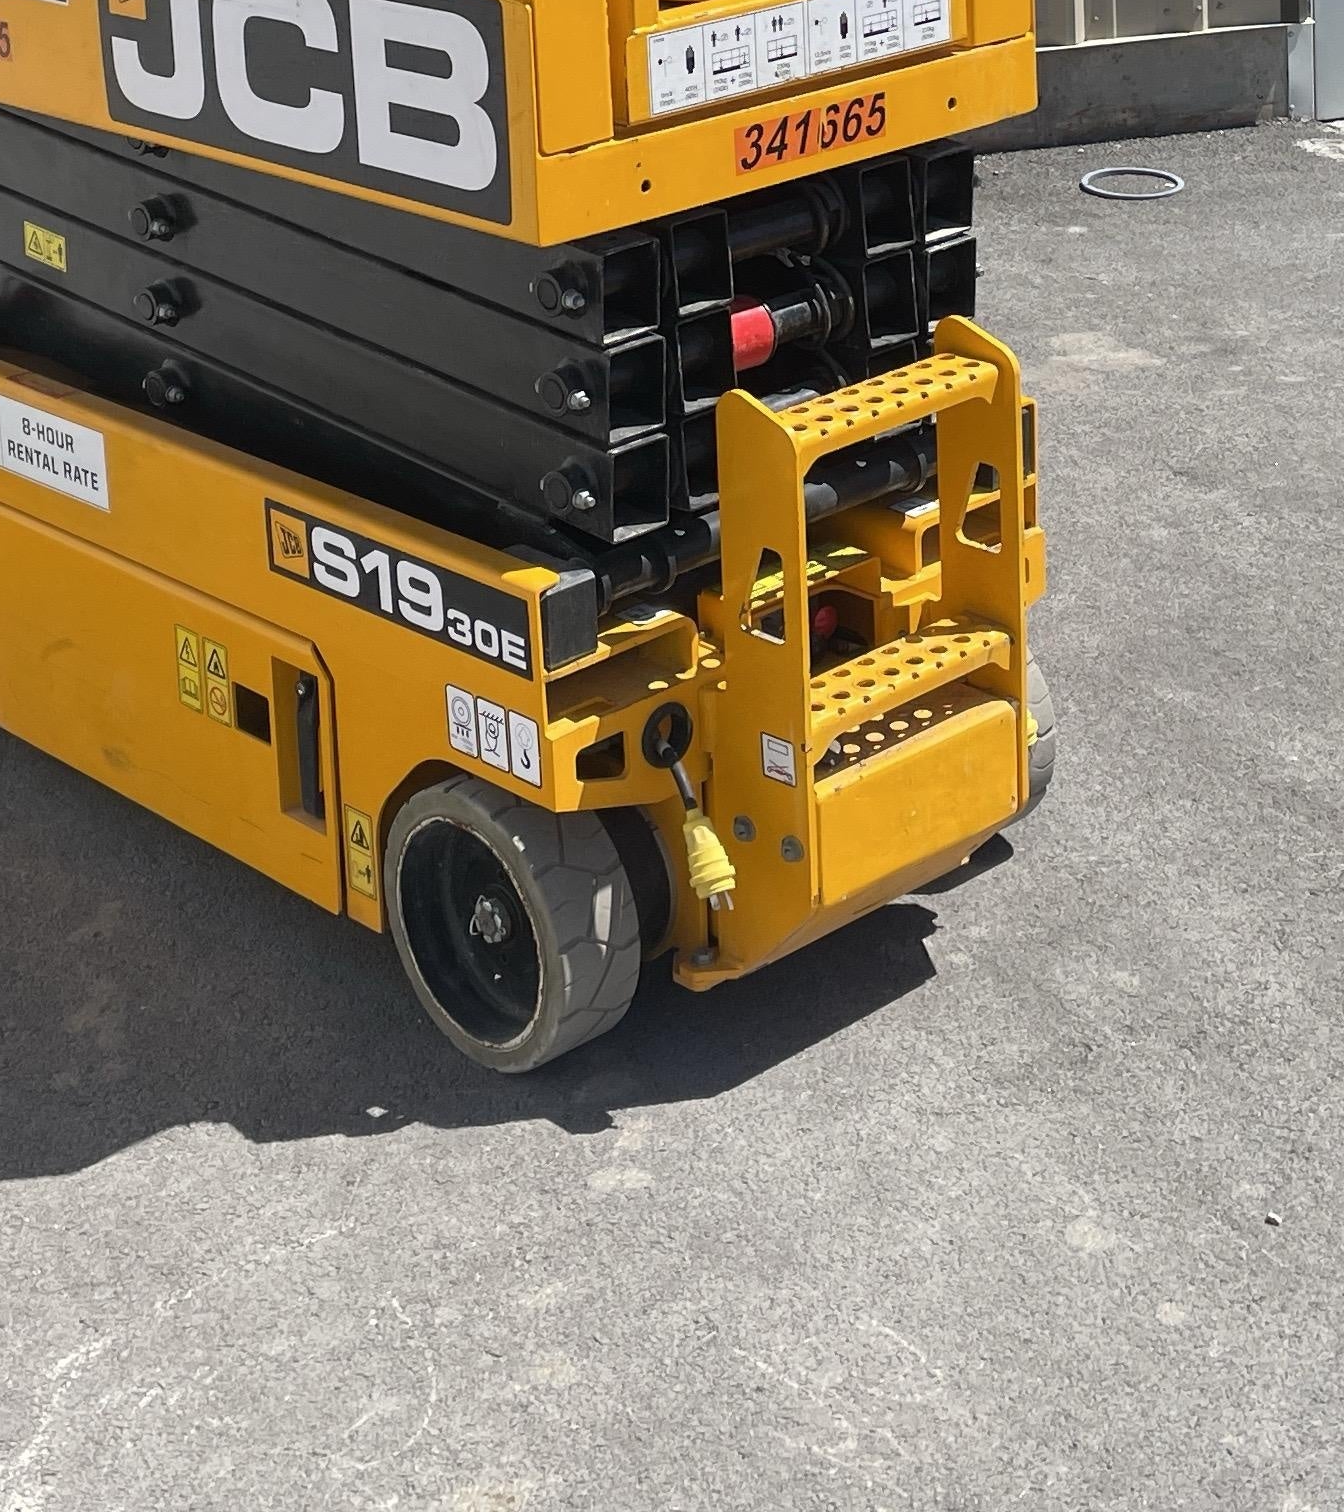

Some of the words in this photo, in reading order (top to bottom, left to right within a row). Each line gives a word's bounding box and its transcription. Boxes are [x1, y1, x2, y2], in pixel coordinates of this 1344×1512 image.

[741, 92, 886, 170] 341665
[22, 417, 74, 454] 8-HOUR
[7, 439, 59, 476] RENTAL
[63, 461, 99, 491] RATE
